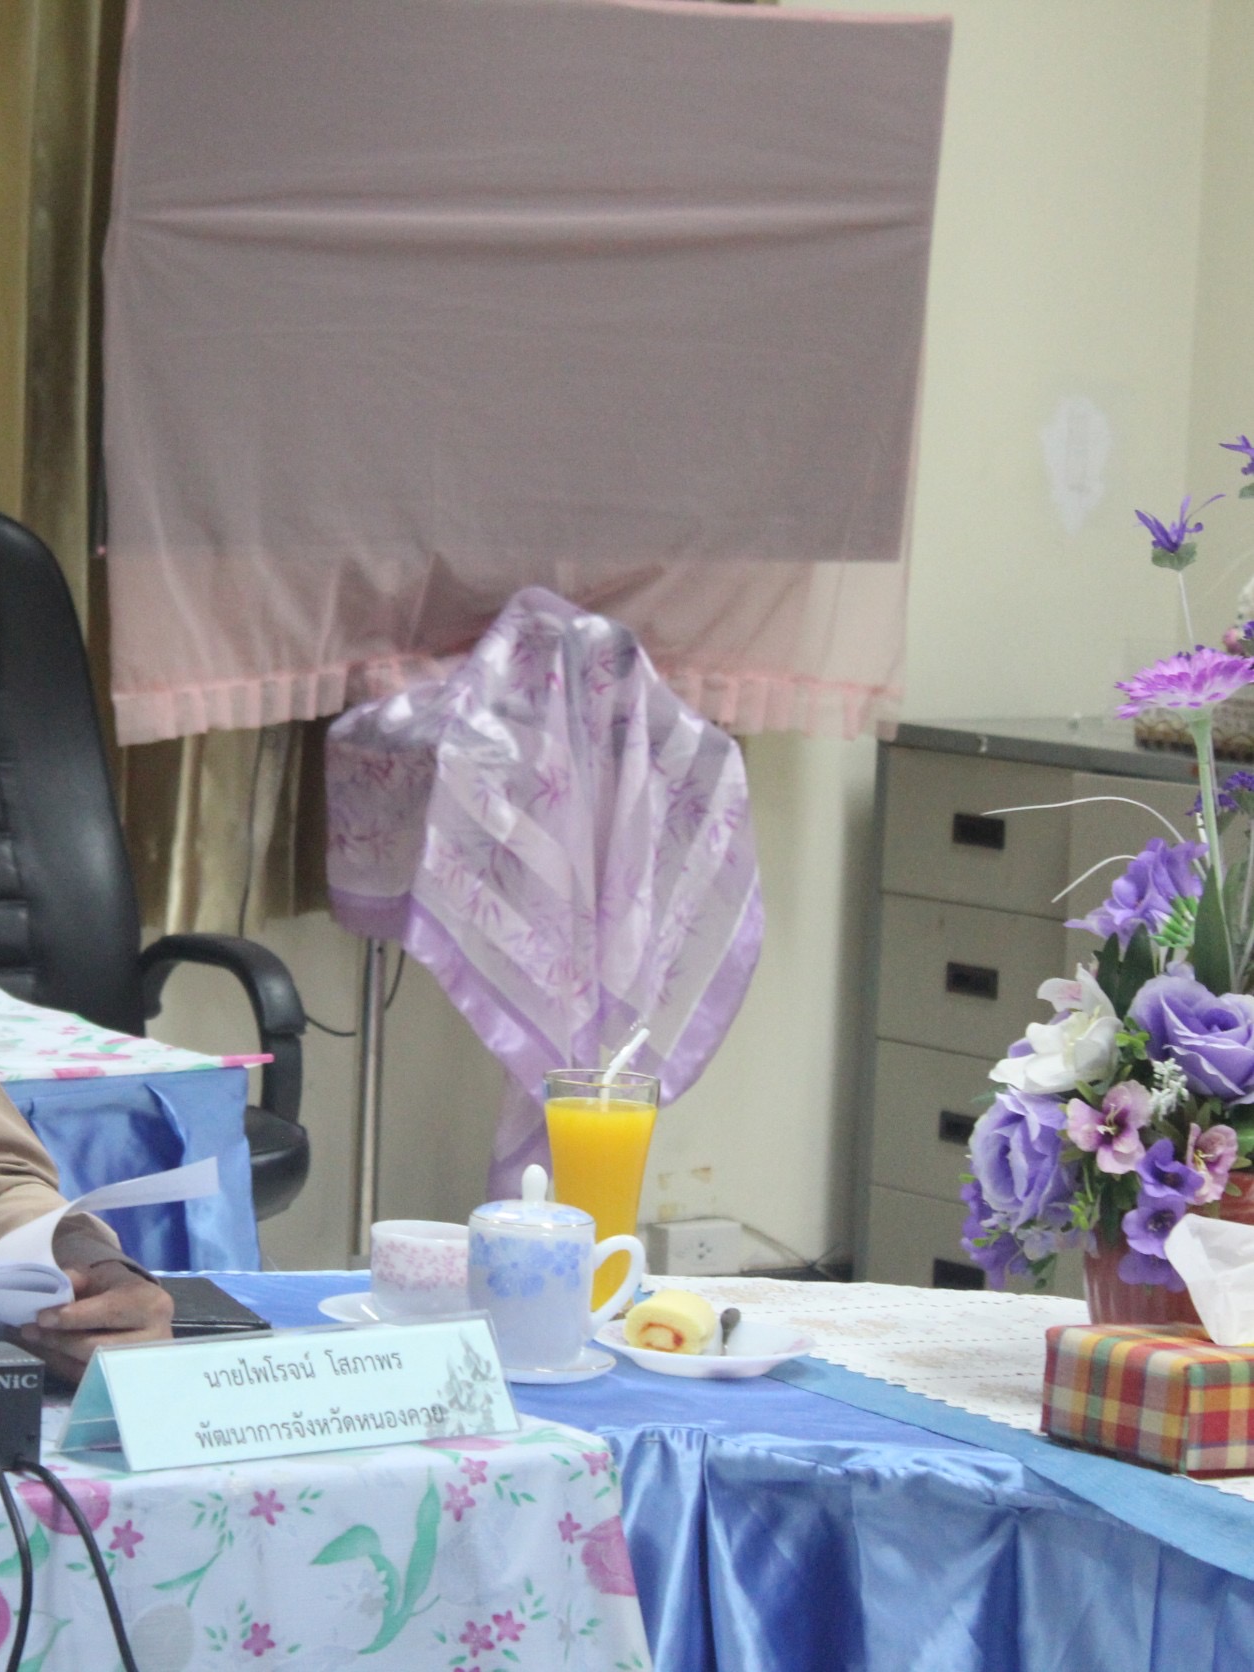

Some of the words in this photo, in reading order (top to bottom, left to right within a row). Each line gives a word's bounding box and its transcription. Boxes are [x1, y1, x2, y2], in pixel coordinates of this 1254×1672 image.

[203, 1352, 315, 1388] นายไพโรจน์
[324, 1349, 403, 1376] โสภาพร
[194, 1403, 445, 1449] พัฒนาการจังหวัดหนองคาย
